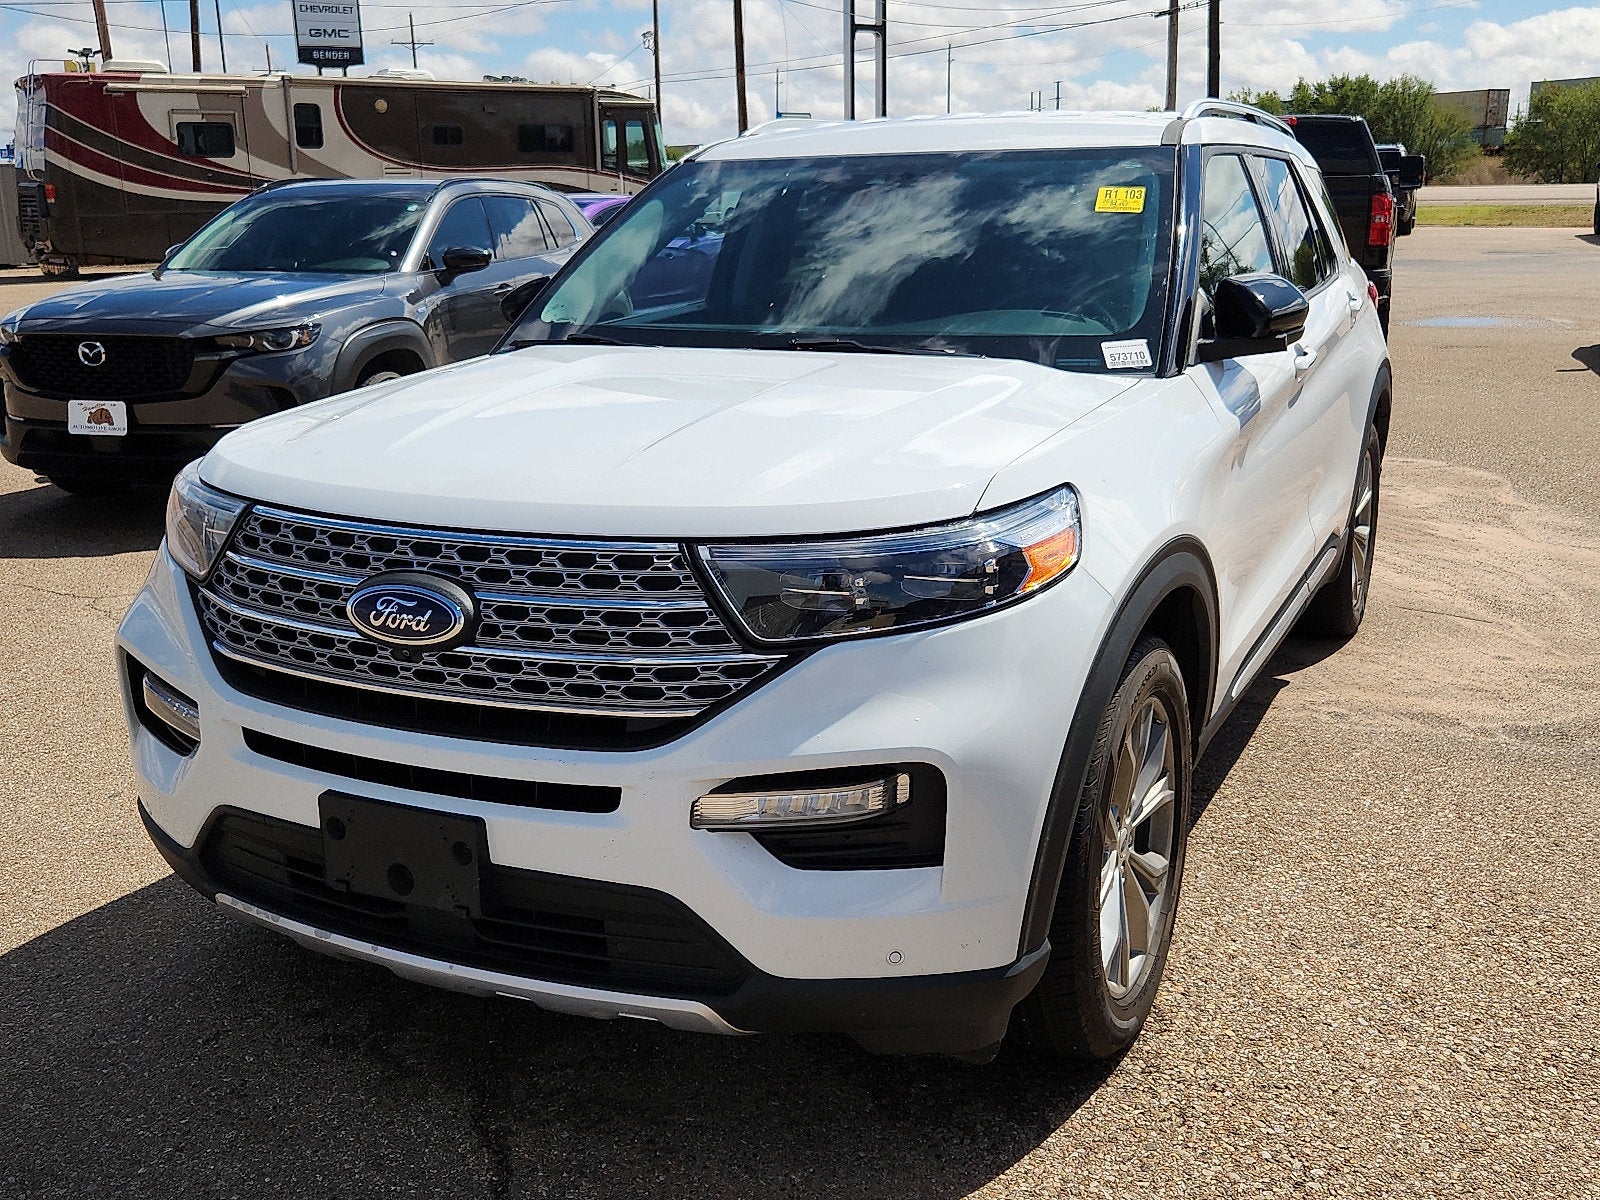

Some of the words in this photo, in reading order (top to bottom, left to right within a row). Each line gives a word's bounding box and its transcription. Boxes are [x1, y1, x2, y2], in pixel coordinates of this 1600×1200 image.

[299, 4, 354, 15] CHEVROLET
[309, 28, 350, 38] GMC
[312, 49, 350, 60] BENDER
[1104, 189, 1119, 199] R1
[1124, 189, 1143, 200] 103
[1109, 351, 1146, 362] 573710
[369, 596, 432, 632] Ford
